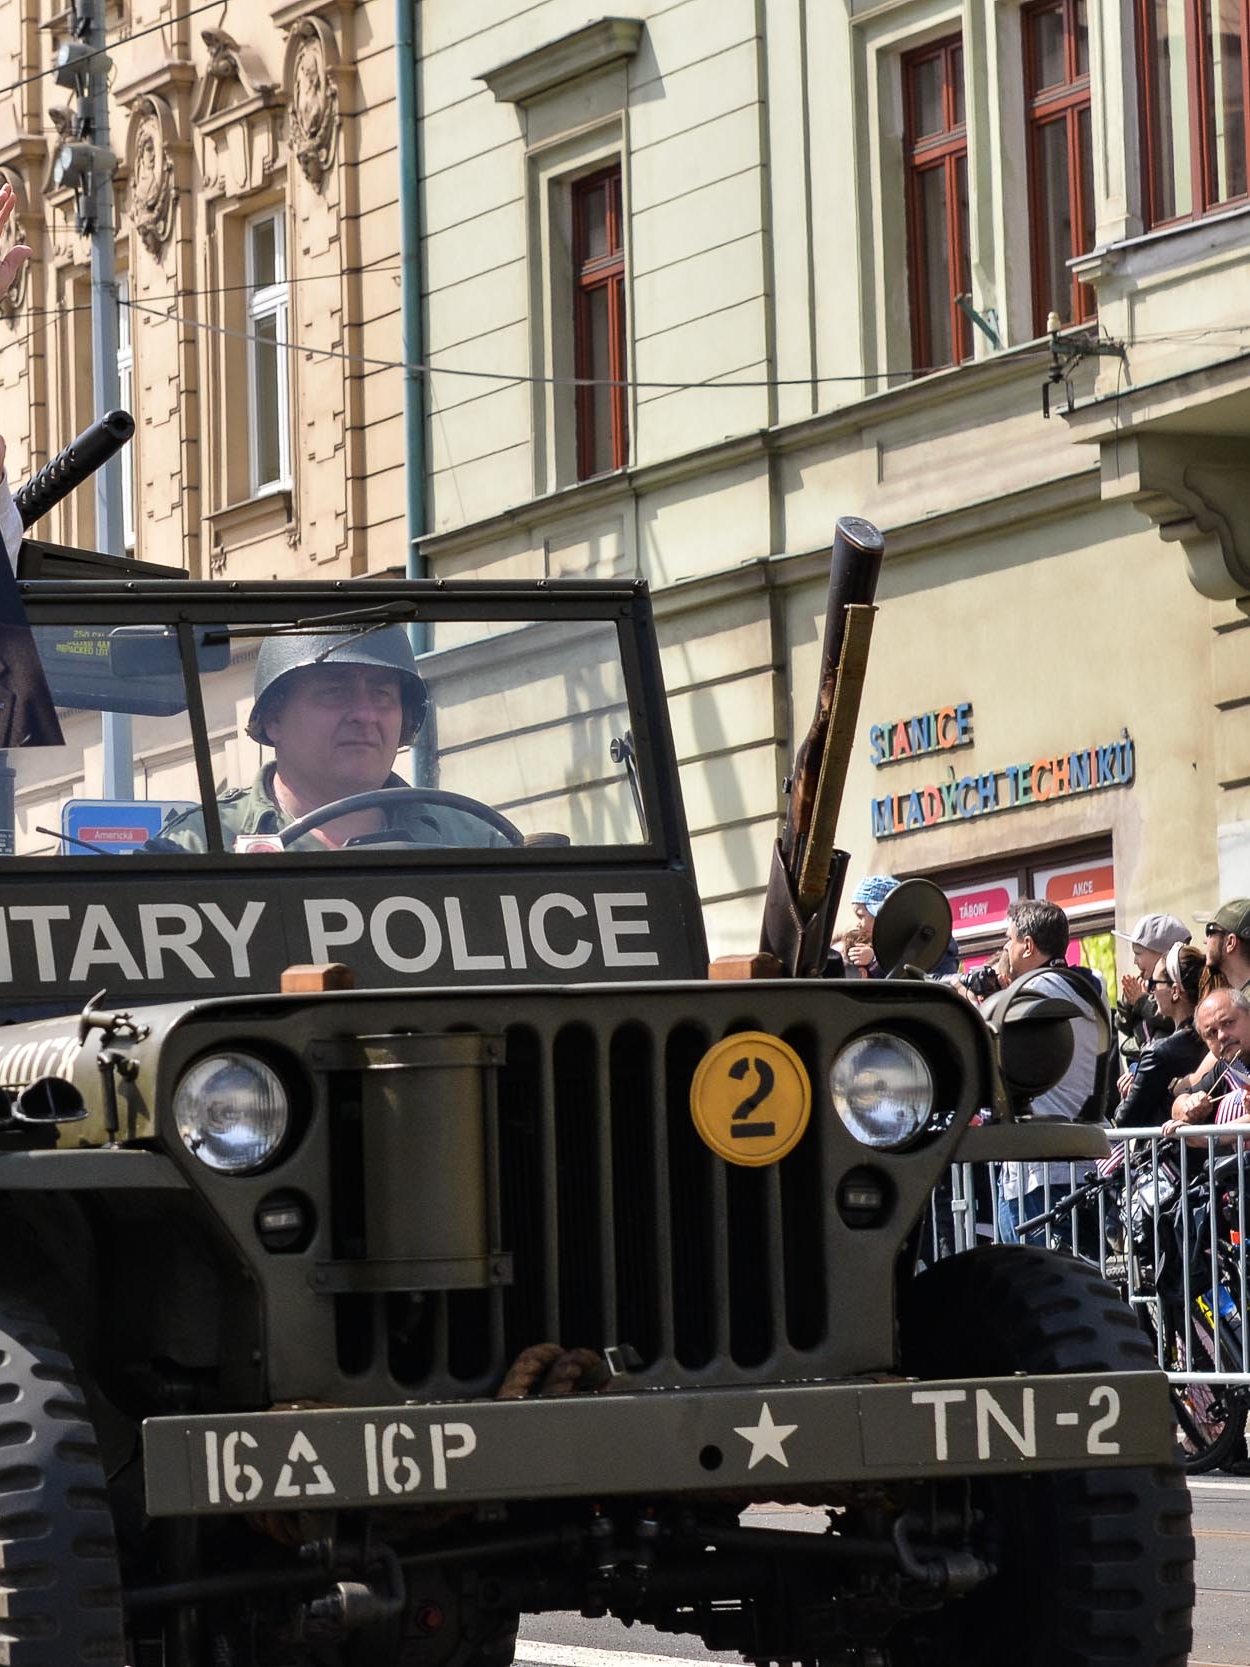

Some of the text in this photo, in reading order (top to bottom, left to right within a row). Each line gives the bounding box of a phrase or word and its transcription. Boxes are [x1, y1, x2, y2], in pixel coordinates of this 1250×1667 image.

[870, 702, 973, 766] STANICE
[871, 727, 1135, 838] MLADÝCH TECHNIKŮ
[94, 831, 134, 841] Americká
[959, 901, 990, 920] TÁBORY
[1072, 880, 1094, 896] AKCE
[303, 891, 661, 974] POLICE
[728, 1056, 776, 1139] 2
[911, 1385, 1121, 1461] TN-2
